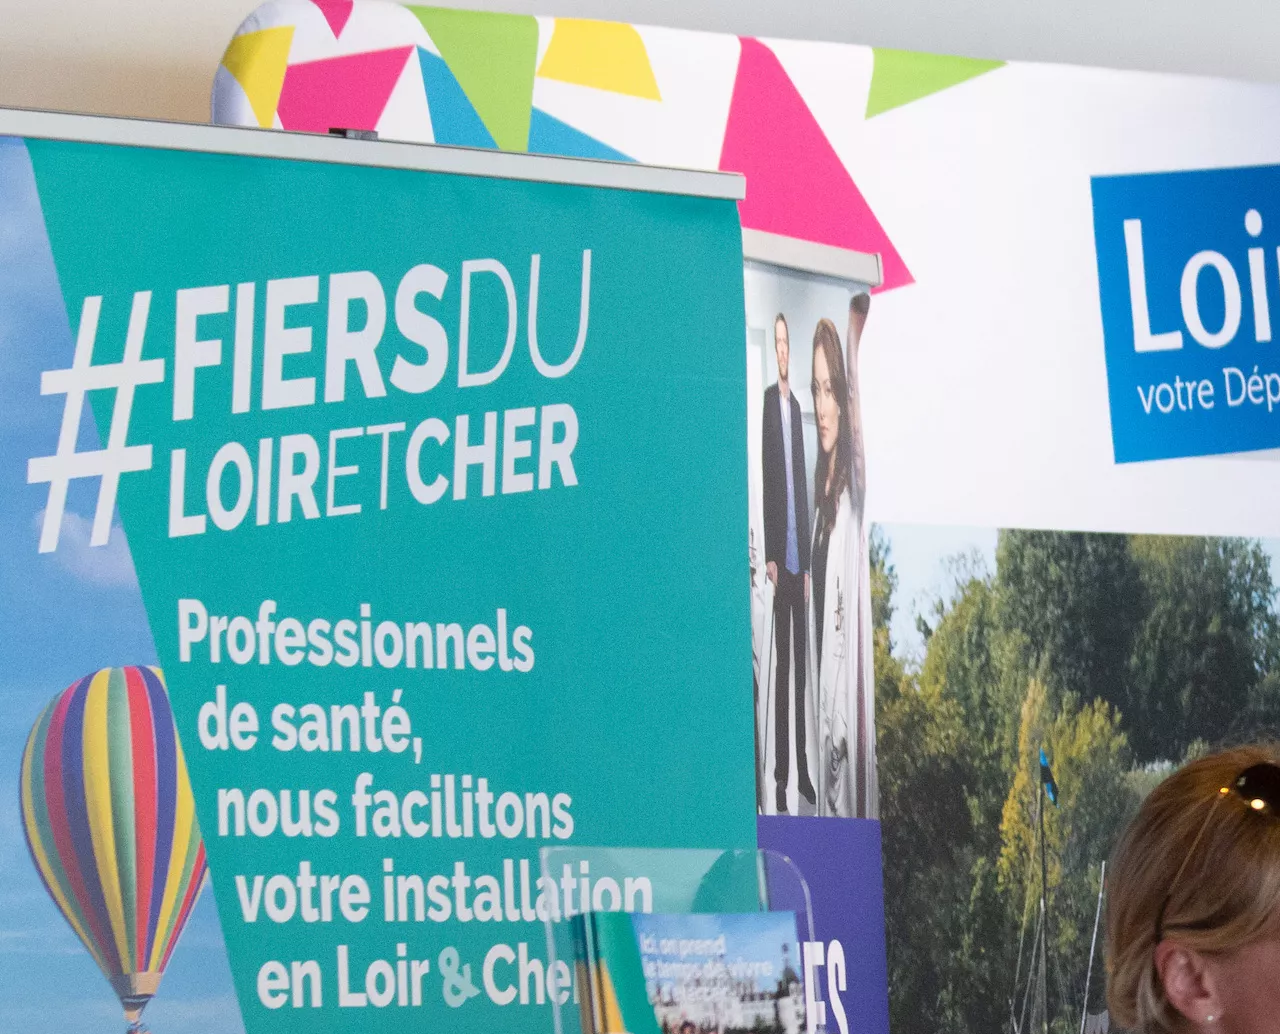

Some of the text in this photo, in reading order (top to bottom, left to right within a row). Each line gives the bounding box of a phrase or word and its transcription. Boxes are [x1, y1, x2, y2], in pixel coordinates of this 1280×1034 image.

[27, 248, 592, 554] #FIERSDU
[1137, 374, 1215, 415] votre
[167, 402, 580, 538] LOIRETCHER
[177, 597, 536, 673] Professionnels
[197, 685, 424, 765] de santé,
[216, 771, 576, 840] nous facilitons
[235, 857, 655, 924] votre installation
[256, 957, 323, 1011] en
[336, 942, 430, 1009] Loir
[437, 945, 482, 1010] &
